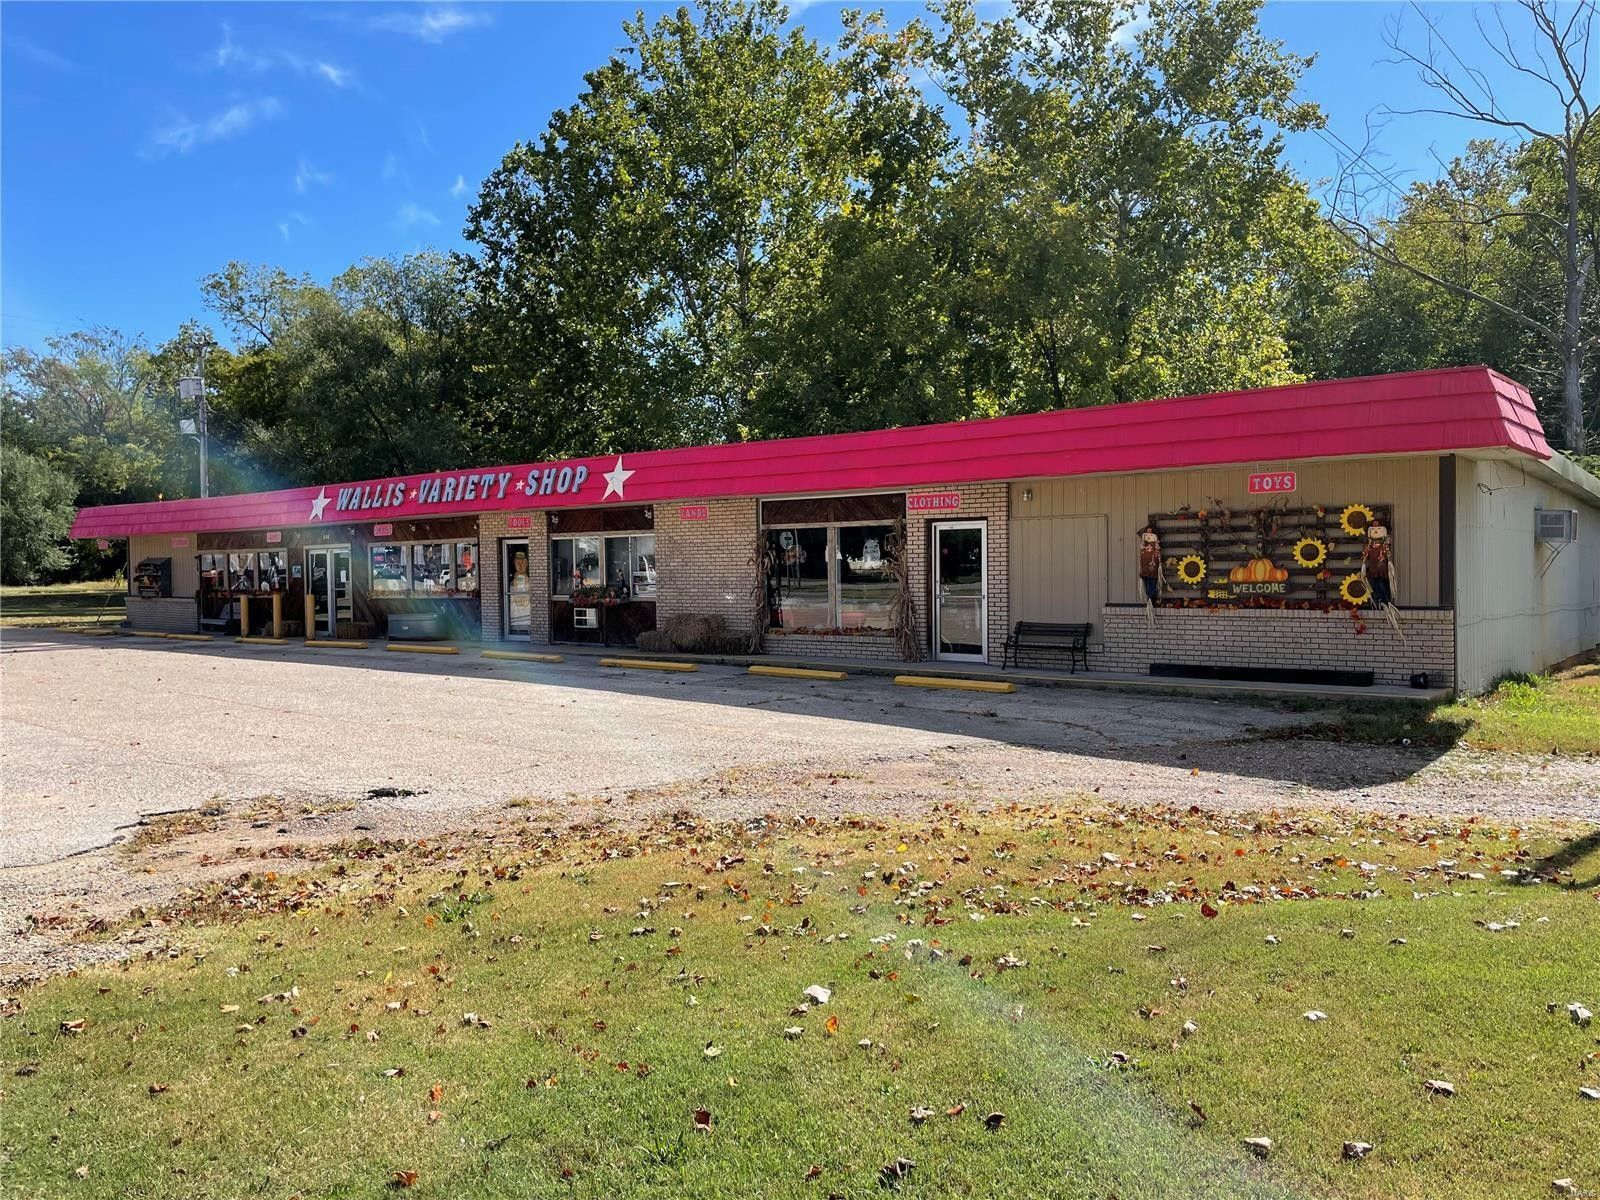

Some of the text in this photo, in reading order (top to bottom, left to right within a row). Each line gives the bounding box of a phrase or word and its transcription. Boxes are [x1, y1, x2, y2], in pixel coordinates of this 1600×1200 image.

[336, 465, 588, 511] WALLIS VARIETY SHOP
[1253, 475, 1292, 490] TOYS
[907, 496, 959, 508] CLOTHING
[1232, 582, 1286, 593] WELCOME
